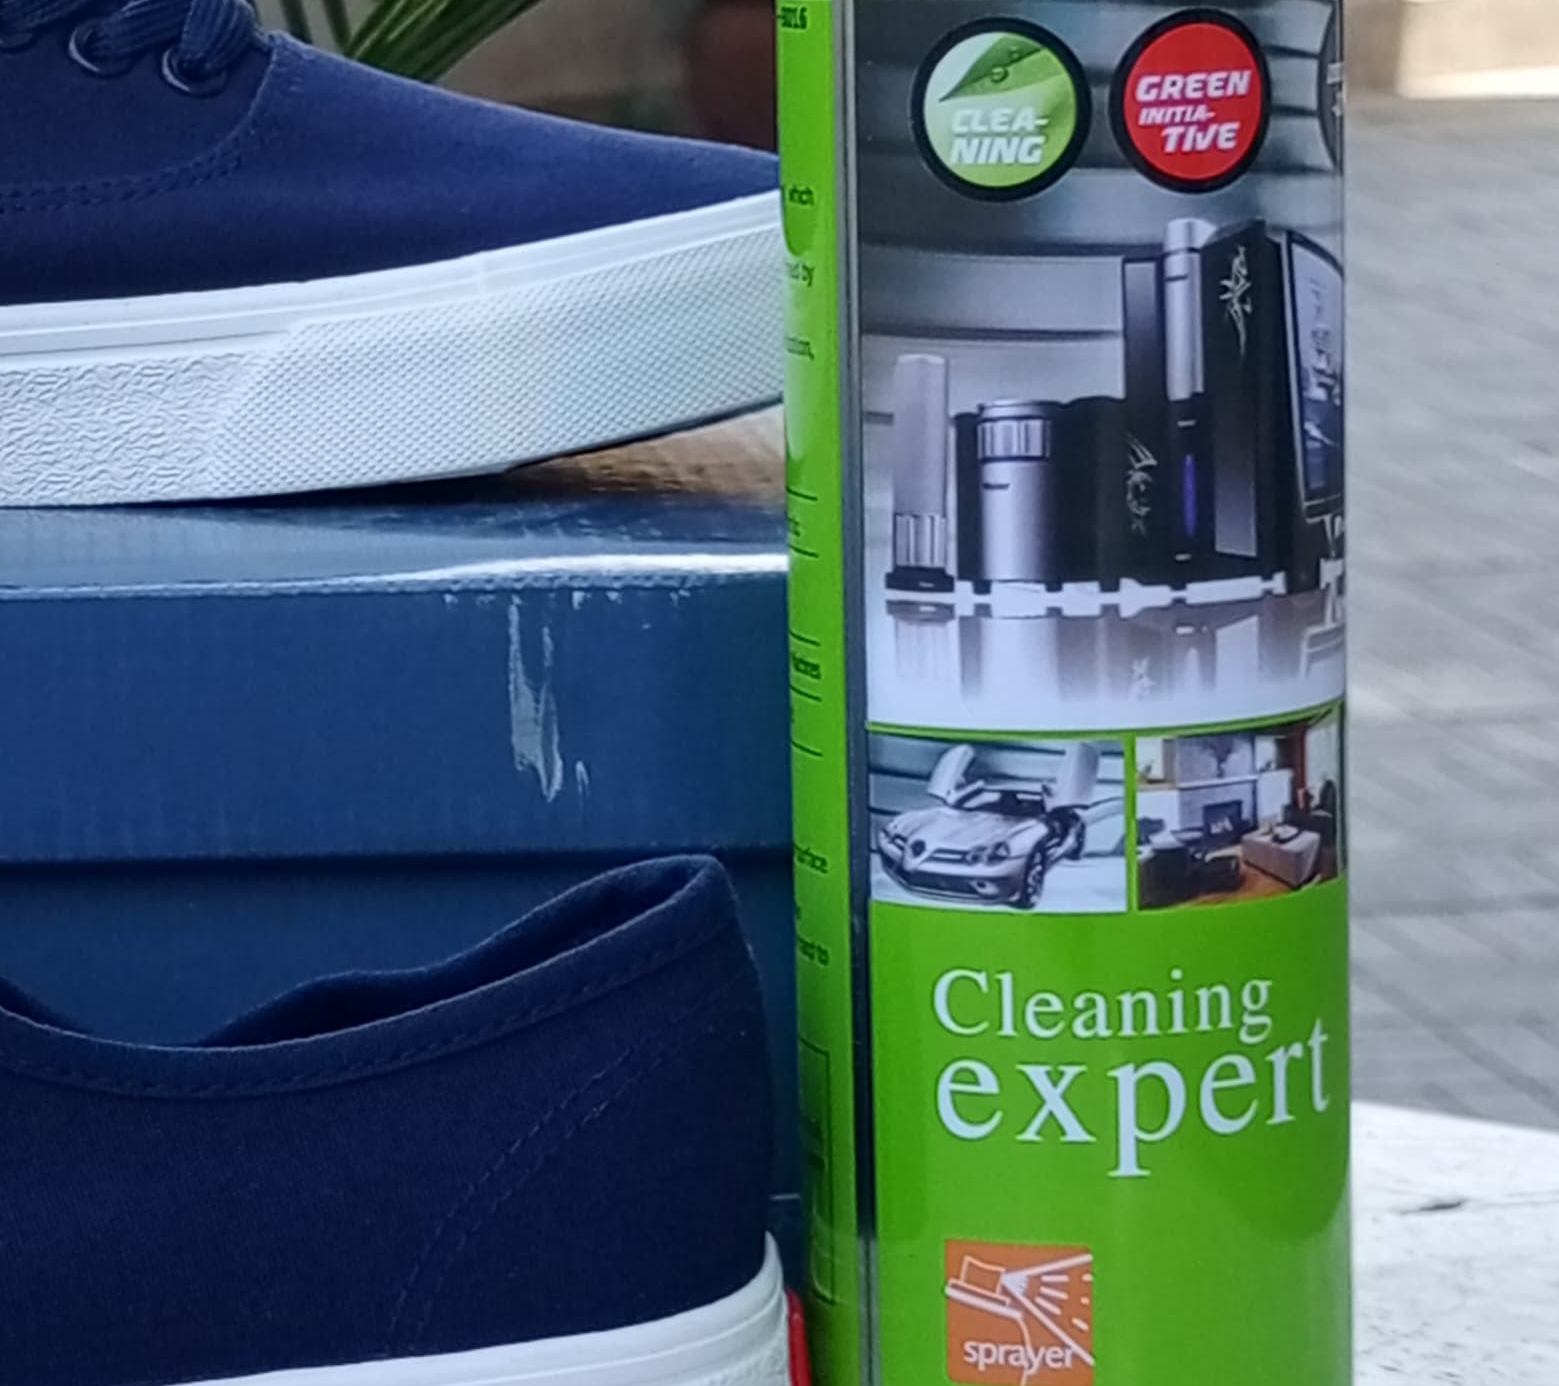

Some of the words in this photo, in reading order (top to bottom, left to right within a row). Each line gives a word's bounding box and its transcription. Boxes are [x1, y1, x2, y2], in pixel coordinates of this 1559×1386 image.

[1136, 71, 1251, 101] GREEN
[950, 108, 1049, 133] CLEA-
[1138, 106, 1216, 125] INITIA-
[949, 134, 1044, 165] NING
[1162, 123, 1239, 152] TIVE
[932, 968, 1274, 1044] Cleaning
[935, 1018, 1331, 1178] expert
[963, 1340, 1076, 1375] sprayer
